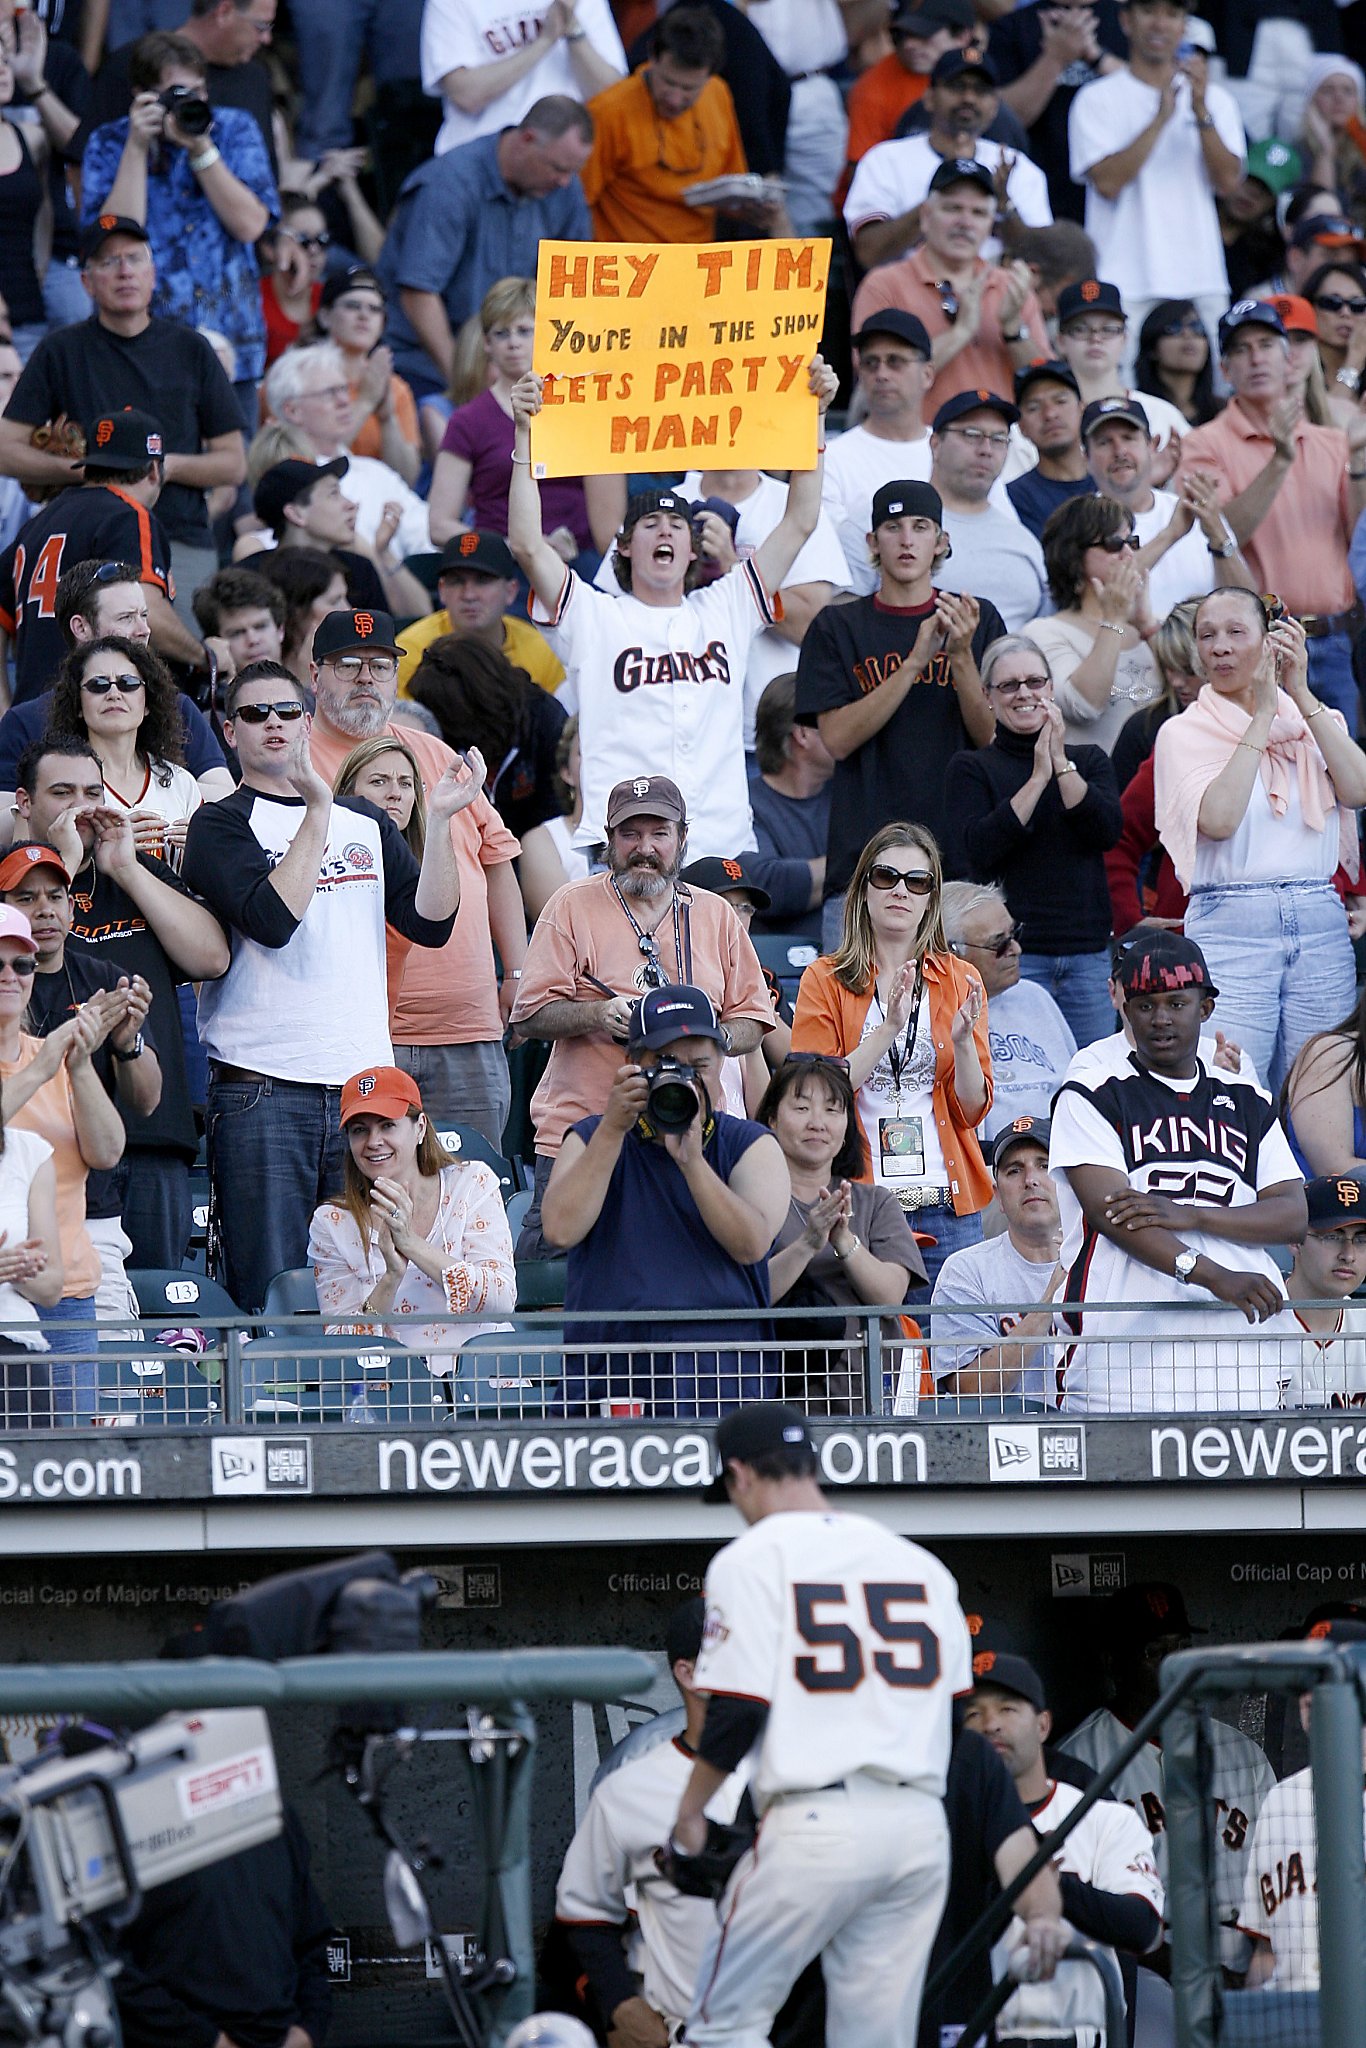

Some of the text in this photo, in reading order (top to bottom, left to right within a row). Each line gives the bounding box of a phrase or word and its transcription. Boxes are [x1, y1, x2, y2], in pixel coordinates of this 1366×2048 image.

[549, 246, 825, 299] HEY TIM,
[659, 325, 688, 348] IN
[709, 320, 755, 345] THE
[770, 313, 819, 338] SHOW
[654, 354, 805, 402] PARTY
[610, 406, 743, 453] MAN!
[353, 612, 374, 639] SF
[633, 779, 650, 798] SF
[721, 859, 743, 881] SF
[75, 892, 94, 913] SF
[358, 1075, 377, 1095] SF
[1131, 1115, 1248, 1174] KING
[1336, 1180, 1360, 1207] SF
[174, 1284, 192, 1300] 13
[1043, 1436, 1078, 1453] NEW
[267, 1449, 303, 1466] NEW
[1043, 1453, 1078, 1470] ERA
[268, 1465, 303, 1483] ERA
[1093, 1562, 1120, 1574] NEW
[1230, 1563, 1291, 1582] Official
[1296, 1562, 1332, 1584] Cap
[1337, 1562, 1356, 1580] of
[467, 1573, 495, 1585] NEW
[607, 1571, 705, 1592] Official Ca
[1094, 1574, 1121, 1586] ERA
[39, 1585, 77, 1607] Cap
[82, 1585, 100, 1603] of
[106, 1584, 160, 1607] Major
[164, 1583, 234, 1606] League
[468, 1585, 496, 1598] ERA
[792, 1582, 942, 1694] 55
